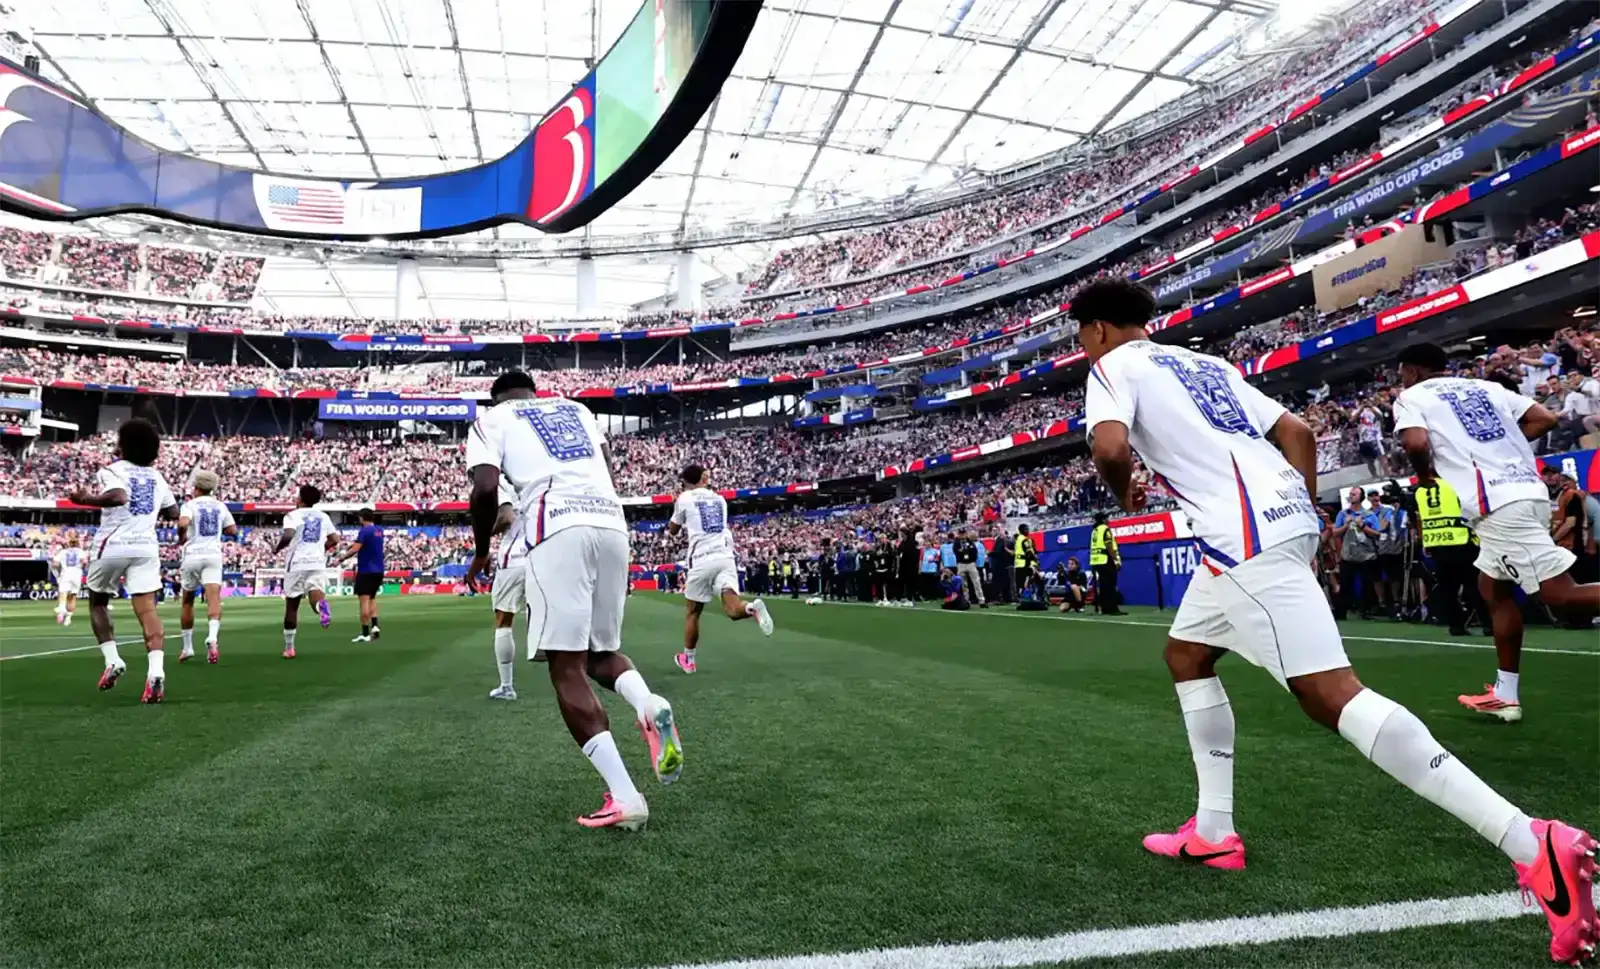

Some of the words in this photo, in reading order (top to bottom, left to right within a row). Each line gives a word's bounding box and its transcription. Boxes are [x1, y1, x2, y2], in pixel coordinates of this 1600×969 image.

[1333, 200, 1355, 219] FIFA
[1356, 182, 1395, 208] WORLD
[1395, 168, 1419, 190] CUP
[1419, 146, 1465, 178] 2026
[1158, 267, 1211, 298] ANGELES
[366, 343, 391, 352] LOS
[393, 343, 451, 352] ANGELES
[326, 404, 353, 415] FIFA
[355, 404, 399, 415] WORLD
[400, 404, 425, 415] CUP
[426, 404, 468, 415] 2026
[548, 505, 579, 519] Men's
[1262, 501, 1301, 523] Men's
[1161, 545, 1196, 575] FIFA
[29, 590, 58, 601] QATA
